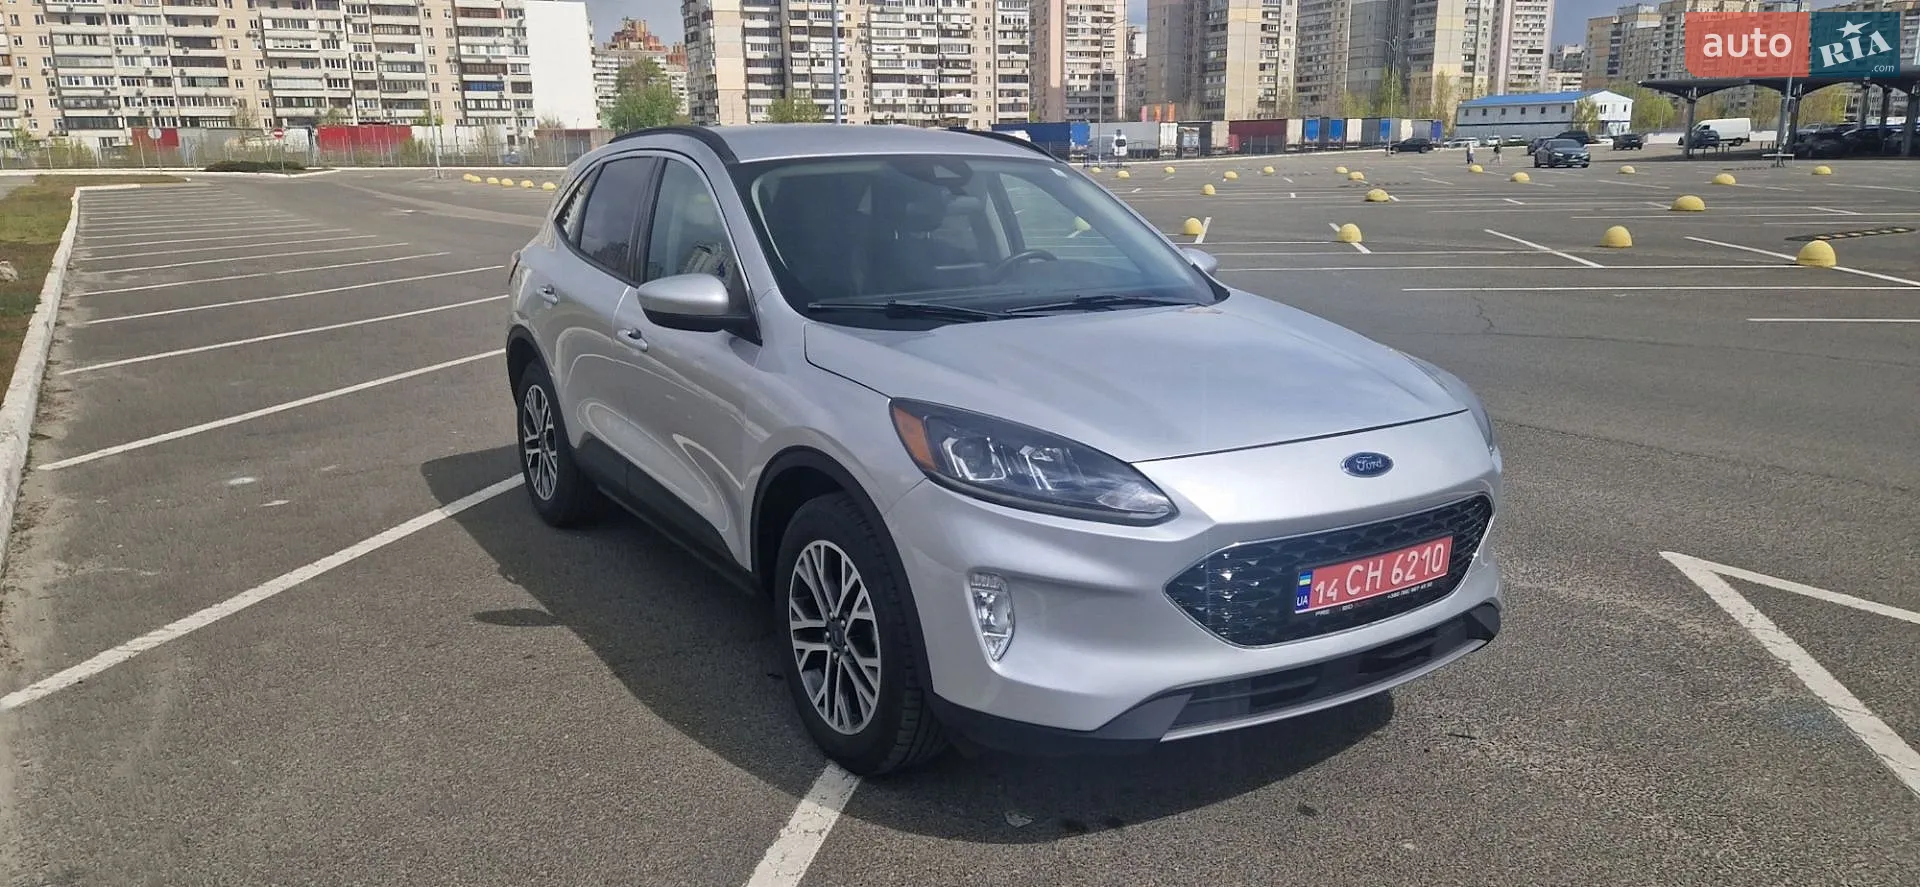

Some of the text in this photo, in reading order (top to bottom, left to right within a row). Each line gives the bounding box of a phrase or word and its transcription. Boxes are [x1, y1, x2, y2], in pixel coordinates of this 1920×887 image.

[1355, 455, 1382, 471] Ford
[1314, 543, 1444, 604] 14 CH 6210
[1296, 596, 1308, 606] UA
